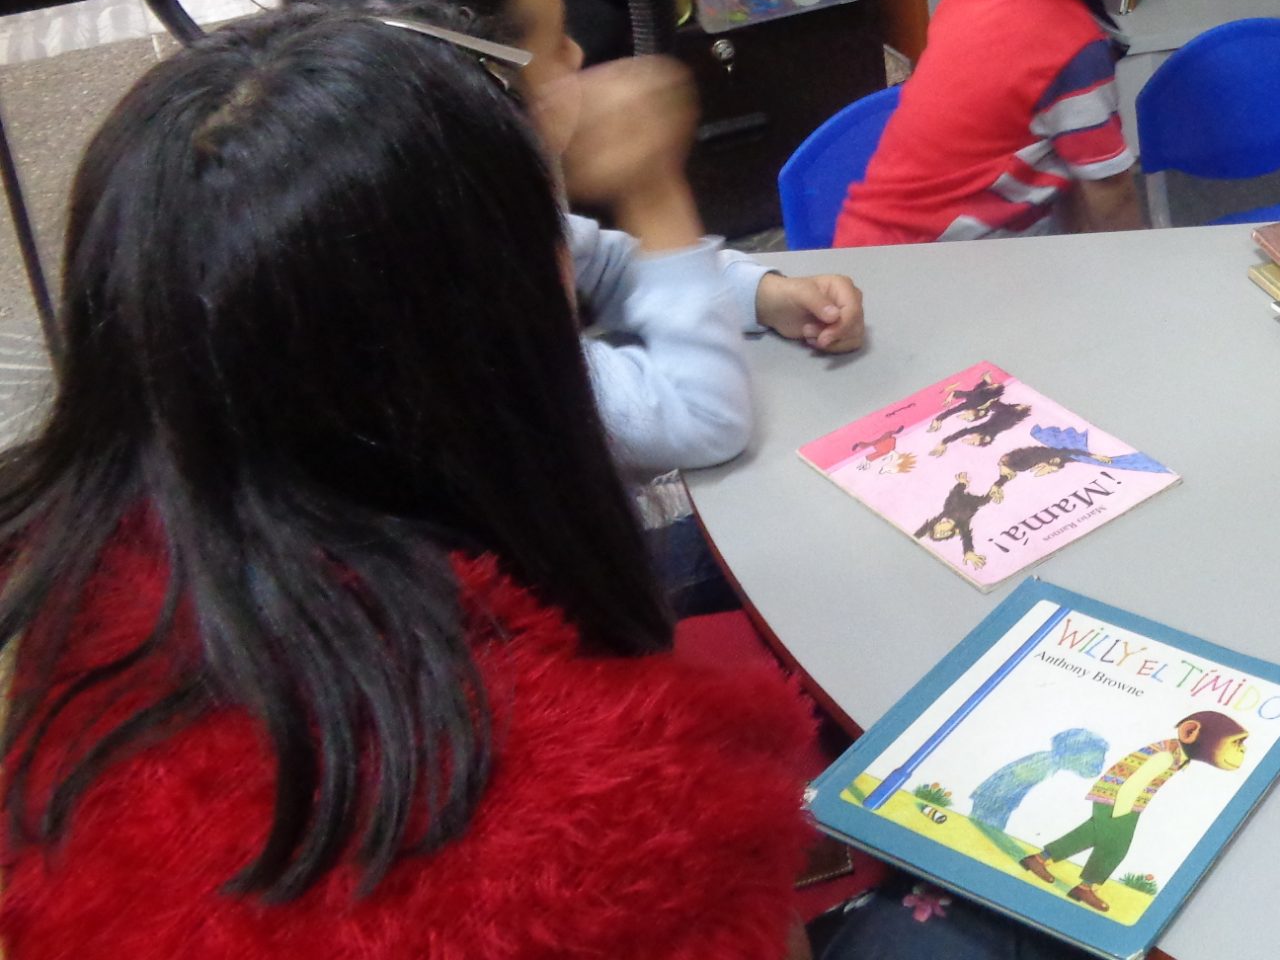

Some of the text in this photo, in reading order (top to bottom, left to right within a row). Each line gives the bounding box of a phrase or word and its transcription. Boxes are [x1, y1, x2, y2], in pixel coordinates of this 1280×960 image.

[1042, 504, 1108, 541] Mario Ramos
[1034, 650, 1145, 697] Anthony Browne
[1136, 659, 1171, 683] EL
